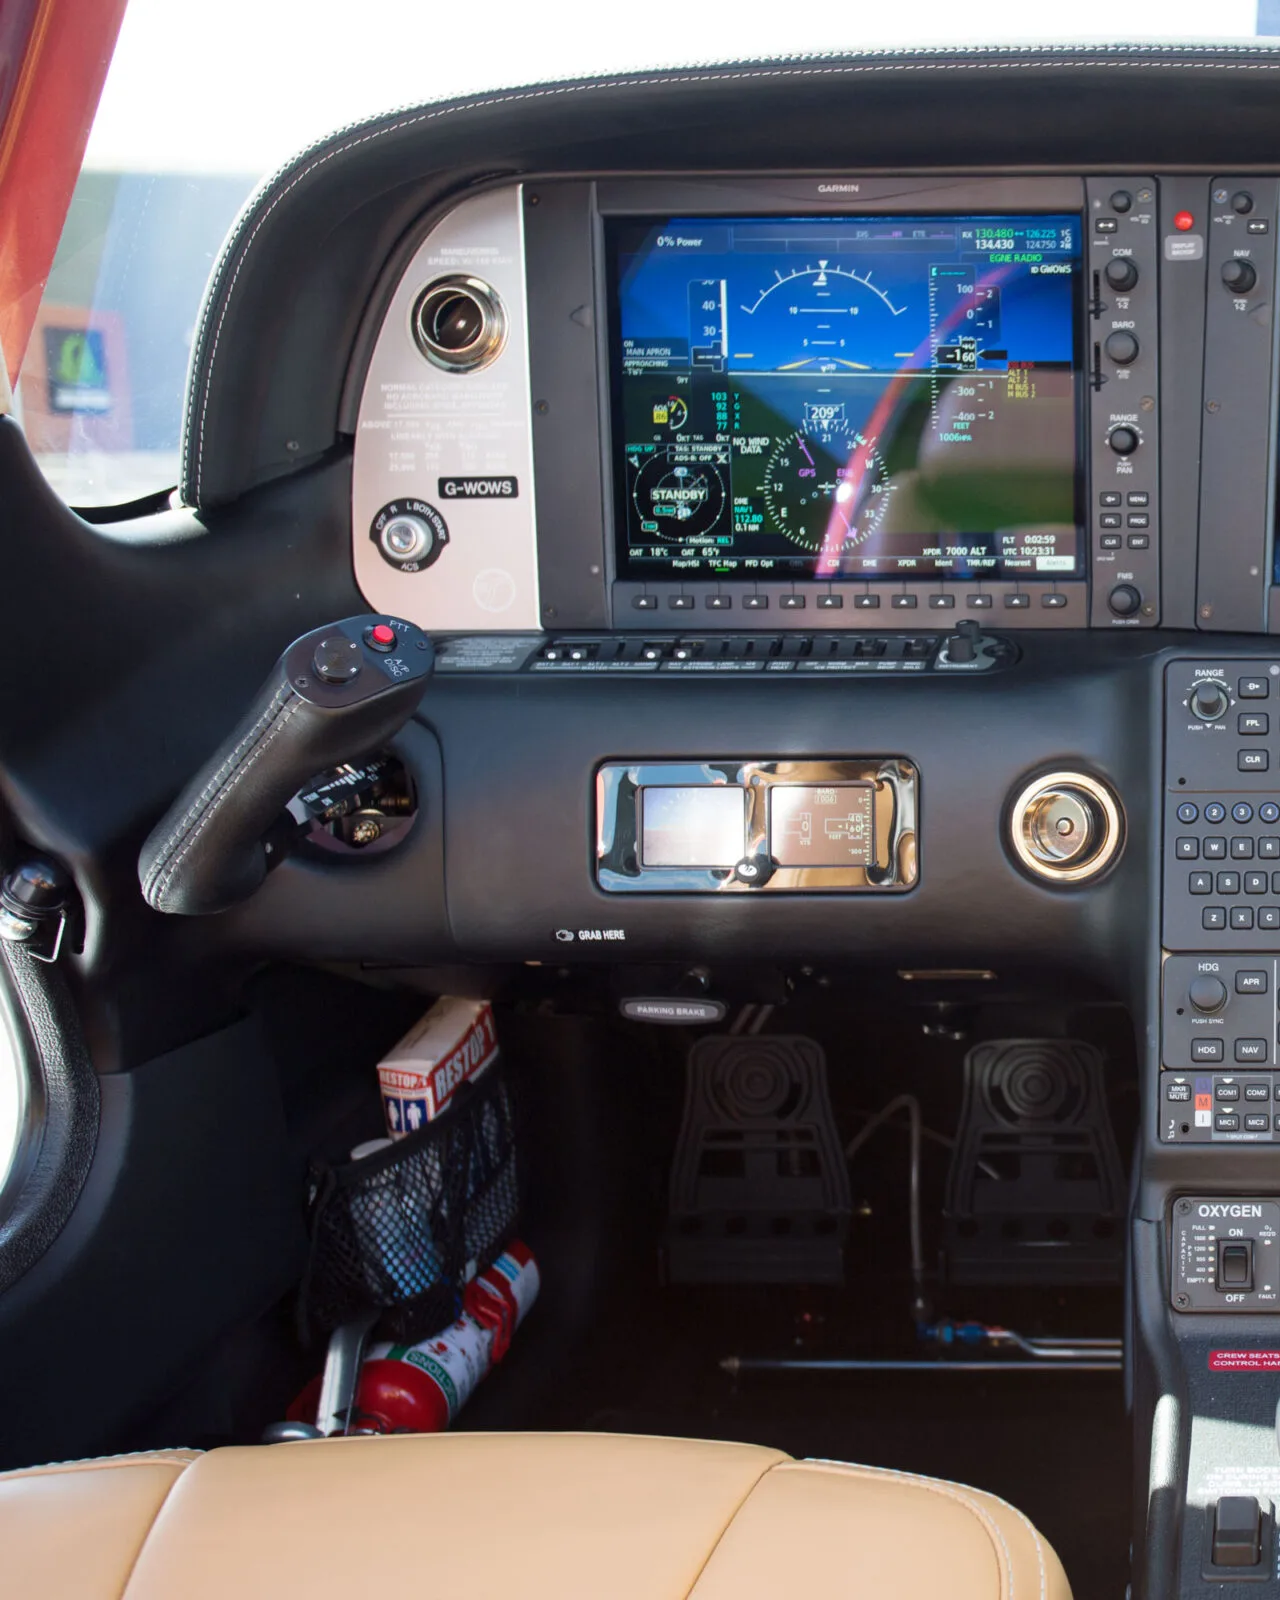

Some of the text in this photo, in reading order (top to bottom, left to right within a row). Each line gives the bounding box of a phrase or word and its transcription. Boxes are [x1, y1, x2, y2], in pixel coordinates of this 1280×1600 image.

[818, 184, 859, 193] GARMIN
[657, 236, 702, 247] 0% Power
[975, 239, 1015, 250] 134.430
[989, 254, 1042, 263] EGNE RADIO
[957, 284, 974, 294] 100
[702, 301, 715, 310] 40
[1112, 321, 1135, 329] BARO
[703, 327, 716, 336] 30
[625, 348, 671, 356] MAIN APRON
[624, 360, 668, 368] APPROACHING
[811, 407, 840, 419] 209°
[1110, 414, 1138, 422] RANGE
[732, 437, 769, 446] NO WIND
[740, 446, 763, 454] DATA
[798, 469, 816, 477] GPS
[445, 481, 512, 495] G-WOWS
[652, 490, 706, 500] STANDBY
[390, 504, 398, 513] R
[413, 502, 434, 519] BOTH
[376, 514, 387, 530] OFF
[734, 515, 763, 523] 112.80
[431, 512, 447, 541] START
[922, 547, 1055, 556] XPDR 7000 ALT UTC 10:23:31
[898, 559, 916, 567] XPDR
[935, 559, 953, 567] Ident
[966, 559, 996, 568] TMR/REF
[1005, 559, 1031, 567] Nearest
[389, 619, 410, 632] PTT
[384, 658, 403, 677] DISC
[1195, 669, 1224, 677] RANGE
[578, 929, 625, 940] GRAB HERE
[1198, 963, 1219, 971] HDG
[637, 1006, 705, 1016] PARKING BRAKE
[434, 1013, 494, 1103] RESTOP 1
[1198, 1205, 1262, 1218] OXYGEN
[1228, 1228, 1244, 1237] ON
[1225, 1294, 1245, 1302] OFF
